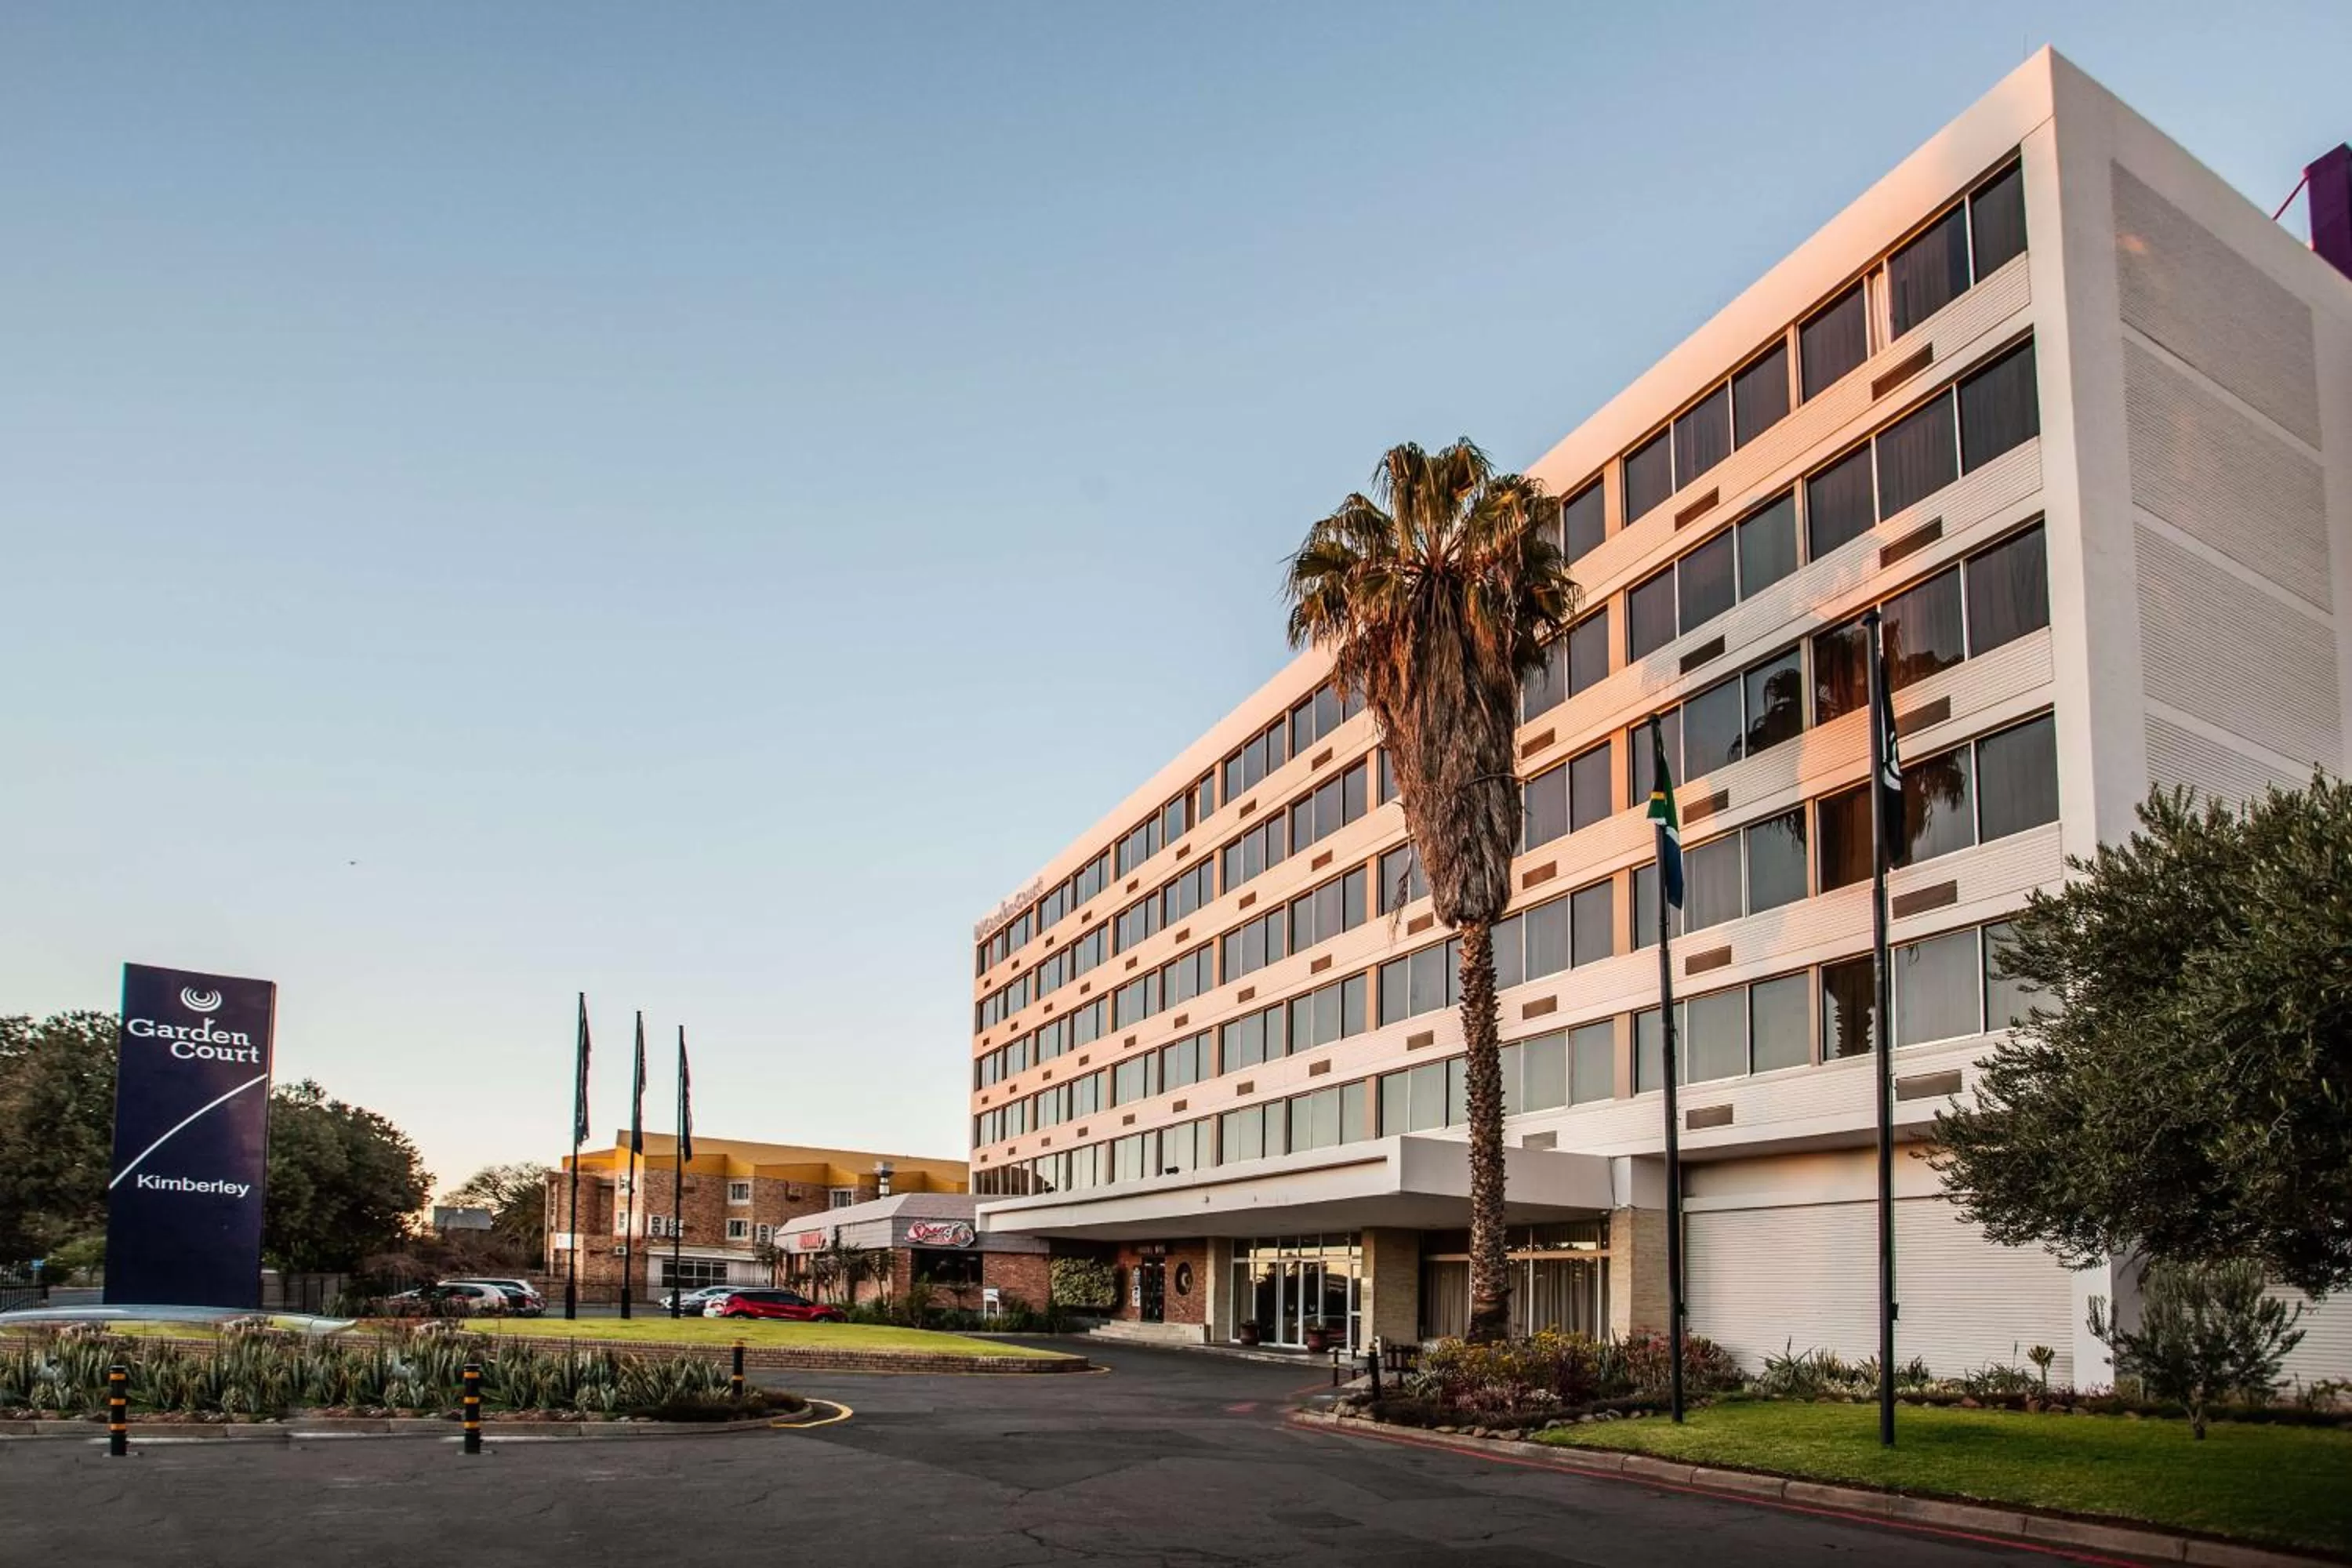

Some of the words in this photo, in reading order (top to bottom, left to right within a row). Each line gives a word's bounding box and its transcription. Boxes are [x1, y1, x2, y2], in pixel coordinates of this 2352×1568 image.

[127, 1018, 250, 1046] Garden
[170, 1041, 260, 1063] Court
[137, 1174, 250, 1198] Kimberley
